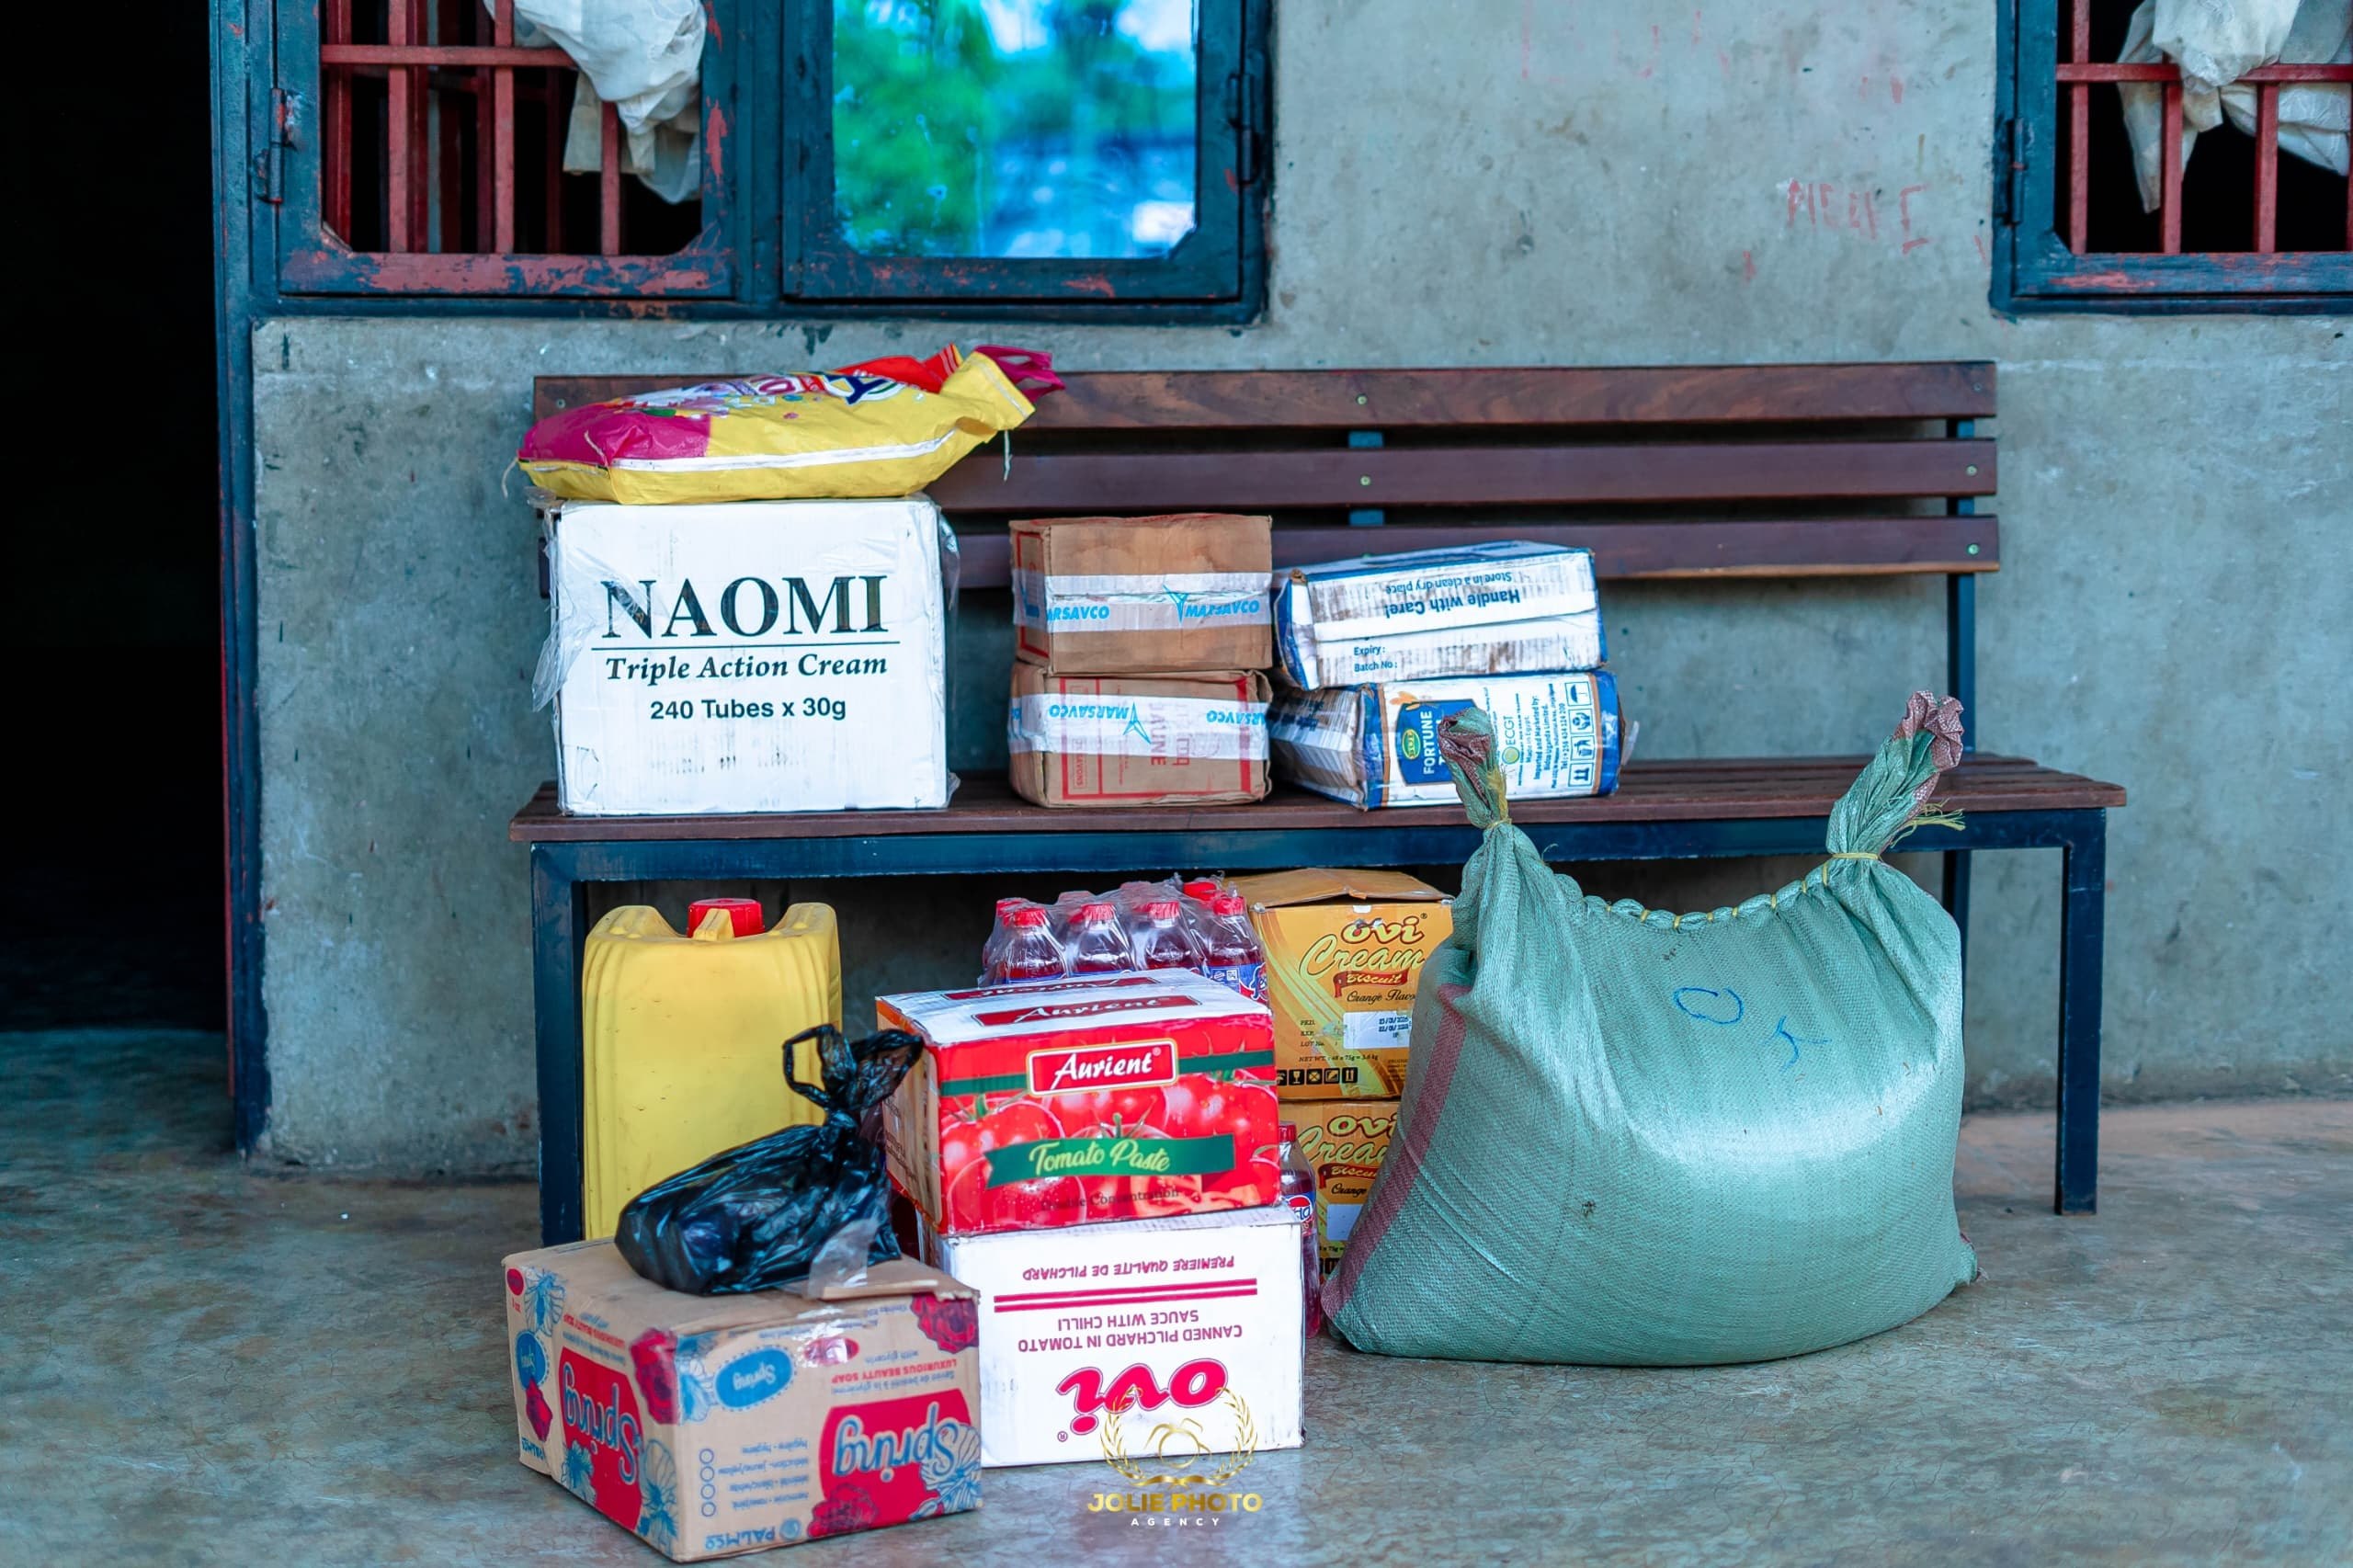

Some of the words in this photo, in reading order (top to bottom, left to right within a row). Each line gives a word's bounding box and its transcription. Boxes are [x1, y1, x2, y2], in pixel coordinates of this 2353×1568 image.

[1415, 579, 1432, 592] dry
[1435, 578, 1461, 589] clean
[1472, 576, 1482, 585] in
[1485, 573, 1512, 583] Store
[1386, 581, 1412, 595] place
[601, 574, 889, 639] NAOMI
[1430, 597, 1463, 612] with
[1468, 589, 1520, 608] Handle
[1048, 606, 1109, 621] ARSAVCO
[1384, 601, 1425, 619] Care!
[606, 656, 690, 686] Triple
[697, 653, 789, 678] Action
[798, 653, 888, 676] Cream
[1354, 662, 1379, 672] Batch
[650, 700, 694, 721] 240
[701, 699, 774, 718] Tubes
[782, 703, 795, 717] x
[802, 697, 847, 721] 30g
[1049, 704, 1129, 720] MARSAVCO
[1206, 710, 1266, 725] ARSAVCO
[1503, 715, 1516, 745] ECGT
[1420, 711, 1436, 774] FORTUNE
[1299, 934, 1426, 981] Cream
[1347, 991, 1382, 1005] Orange
[1385, 989, 1415, 1000] Flavo
[1014, 998, 1161, 1023] Aurient
[1051, 1052, 1152, 1090] Aurient
[1296, 1125, 1387, 1165] Crea
[1029, 1141, 1105, 1176] Tomato
[1110, 1140, 1170, 1172] Paste
[1092, 1265, 1108, 1276] DE
[1113, 1259, 1168, 1275] QUALITE
[1173, 1256, 1234, 1271] PREMIERE
[1022, 1266, 1087, 1280] PILCHARD
[1058, 1315, 1102, 1331] CHILLI
[1107, 1314, 1146, 1328] WITH
[1151, 1310, 1199, 1324] SAUCE
[1086, 1335, 1101, 1347] IN
[1106, 1330, 1178, 1346] PILCHARD
[1182, 1324, 1243, 1342] CANNED
[1018, 1337, 1083, 1352] TOMATO
[862, 1367, 900, 1381] BEAUTY
[904, 1358, 957, 1374] LUXURIOUS
[733, 1362, 777, 1391] Spring
[831, 1372, 858, 1383] SOAP
[562, 1363, 639, 1483] Spring
[833, 1402, 959, 1482] Spring
[705, 1527, 775, 1550] PALMCO
